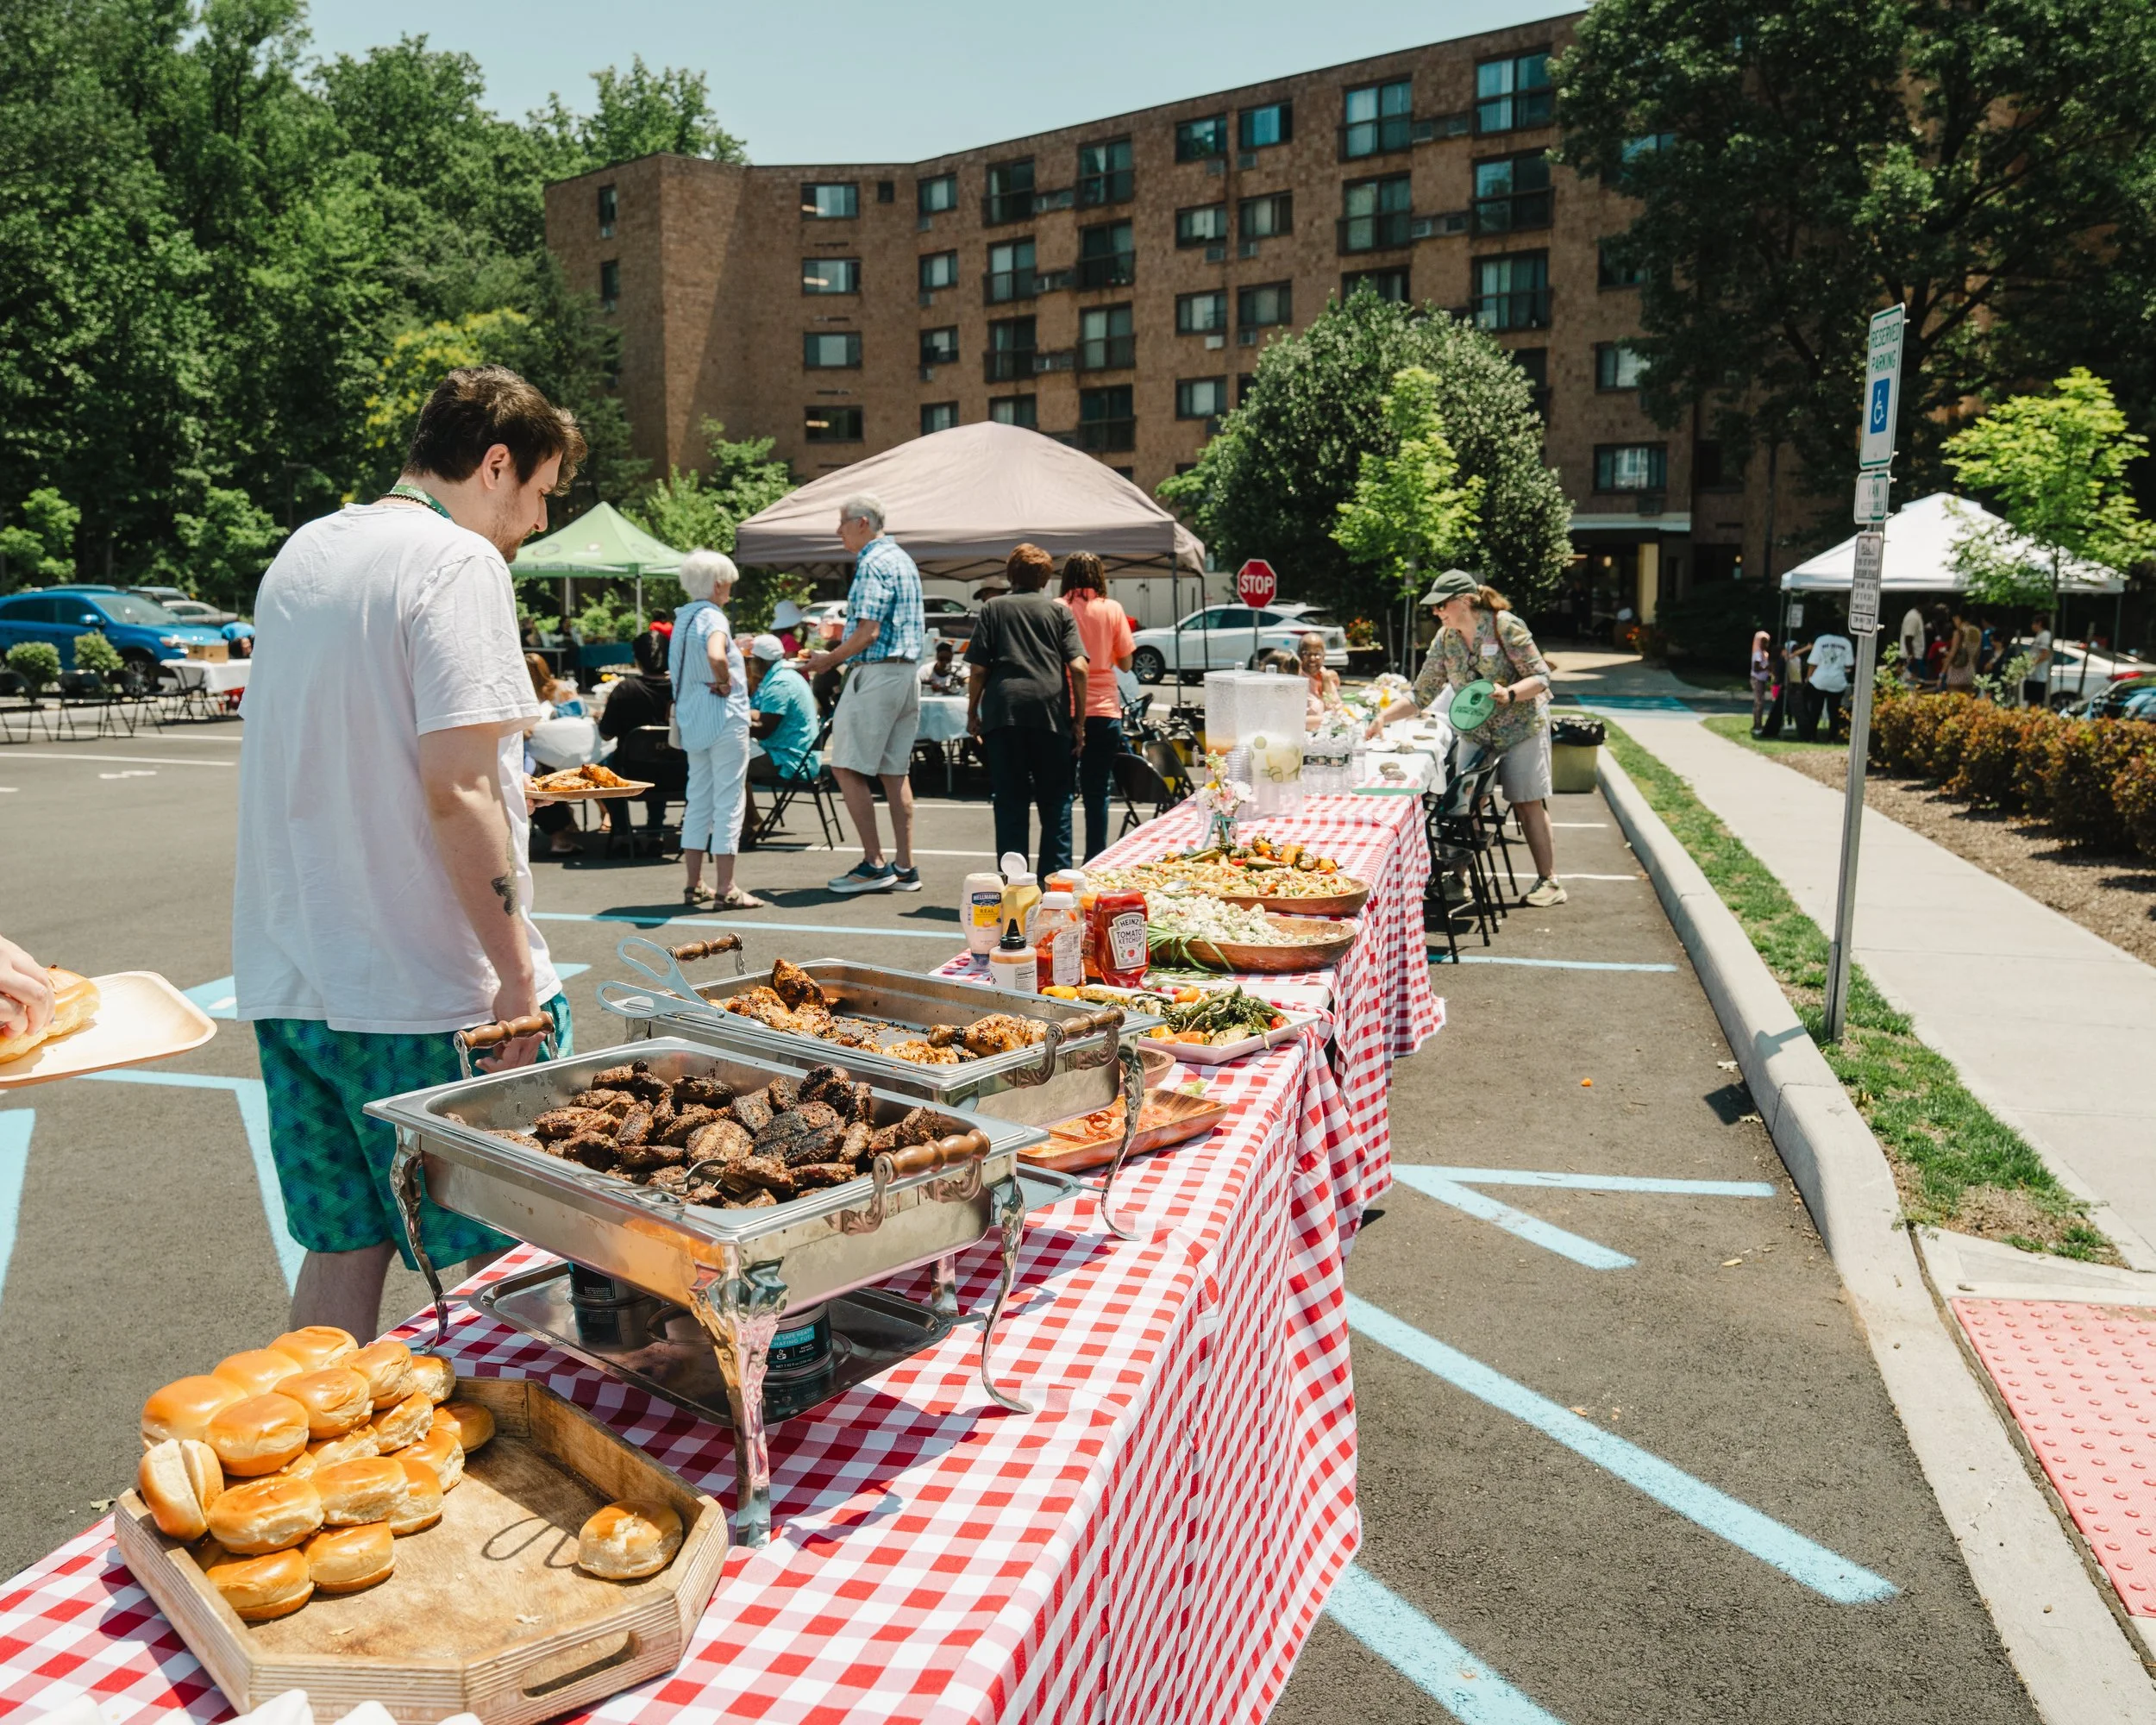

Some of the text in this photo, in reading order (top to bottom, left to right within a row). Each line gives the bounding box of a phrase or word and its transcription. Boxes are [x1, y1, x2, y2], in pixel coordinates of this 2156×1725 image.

[1871, 322, 1900, 349] RESERVED
[1871, 350, 1896, 373] PARKING
[1240, 574, 1274, 594] STOP
[1119, 918, 1139, 927] HEINZ
[1116, 929, 1143, 939] TOMATO
[1118, 935, 1142, 945] KETCHUP
